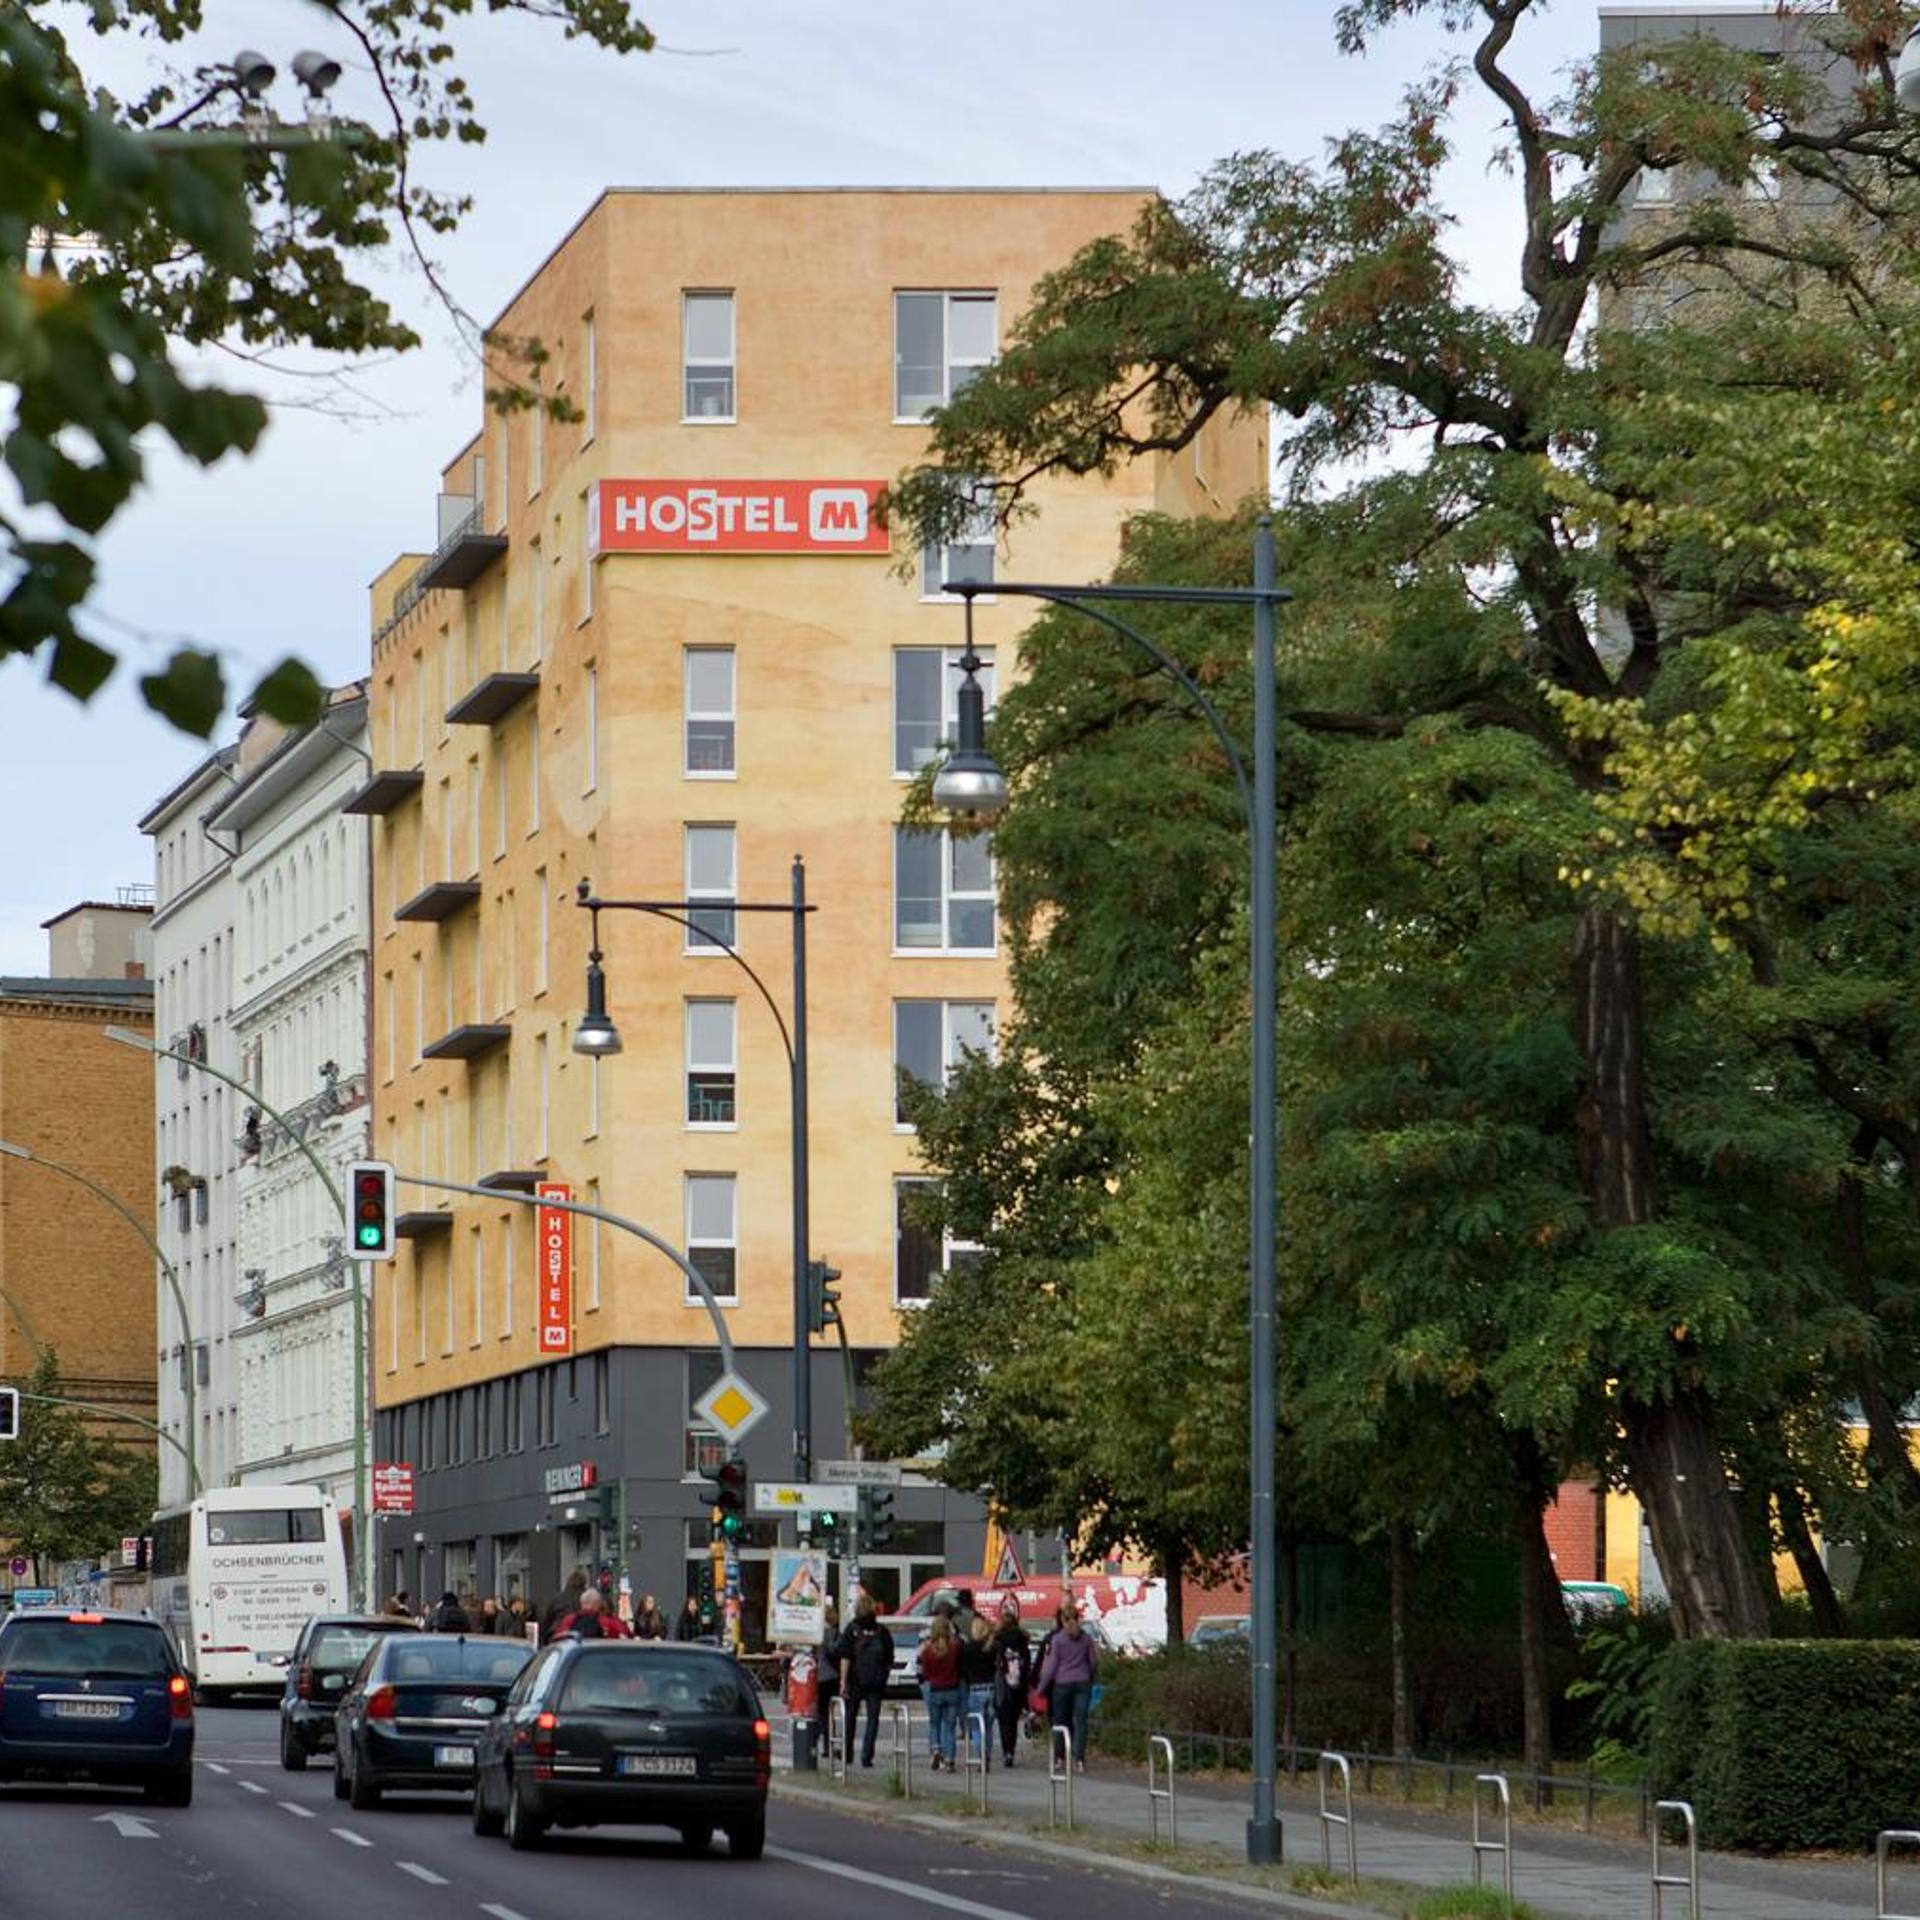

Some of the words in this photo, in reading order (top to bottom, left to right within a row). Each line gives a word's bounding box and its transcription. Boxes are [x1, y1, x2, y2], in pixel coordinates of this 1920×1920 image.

[616, 496, 797, 532] HOSTEL
[548, 1216, 563, 1320] HOSTEL
[212, 1552, 325, 1568] OCHSENBRÜCHER
